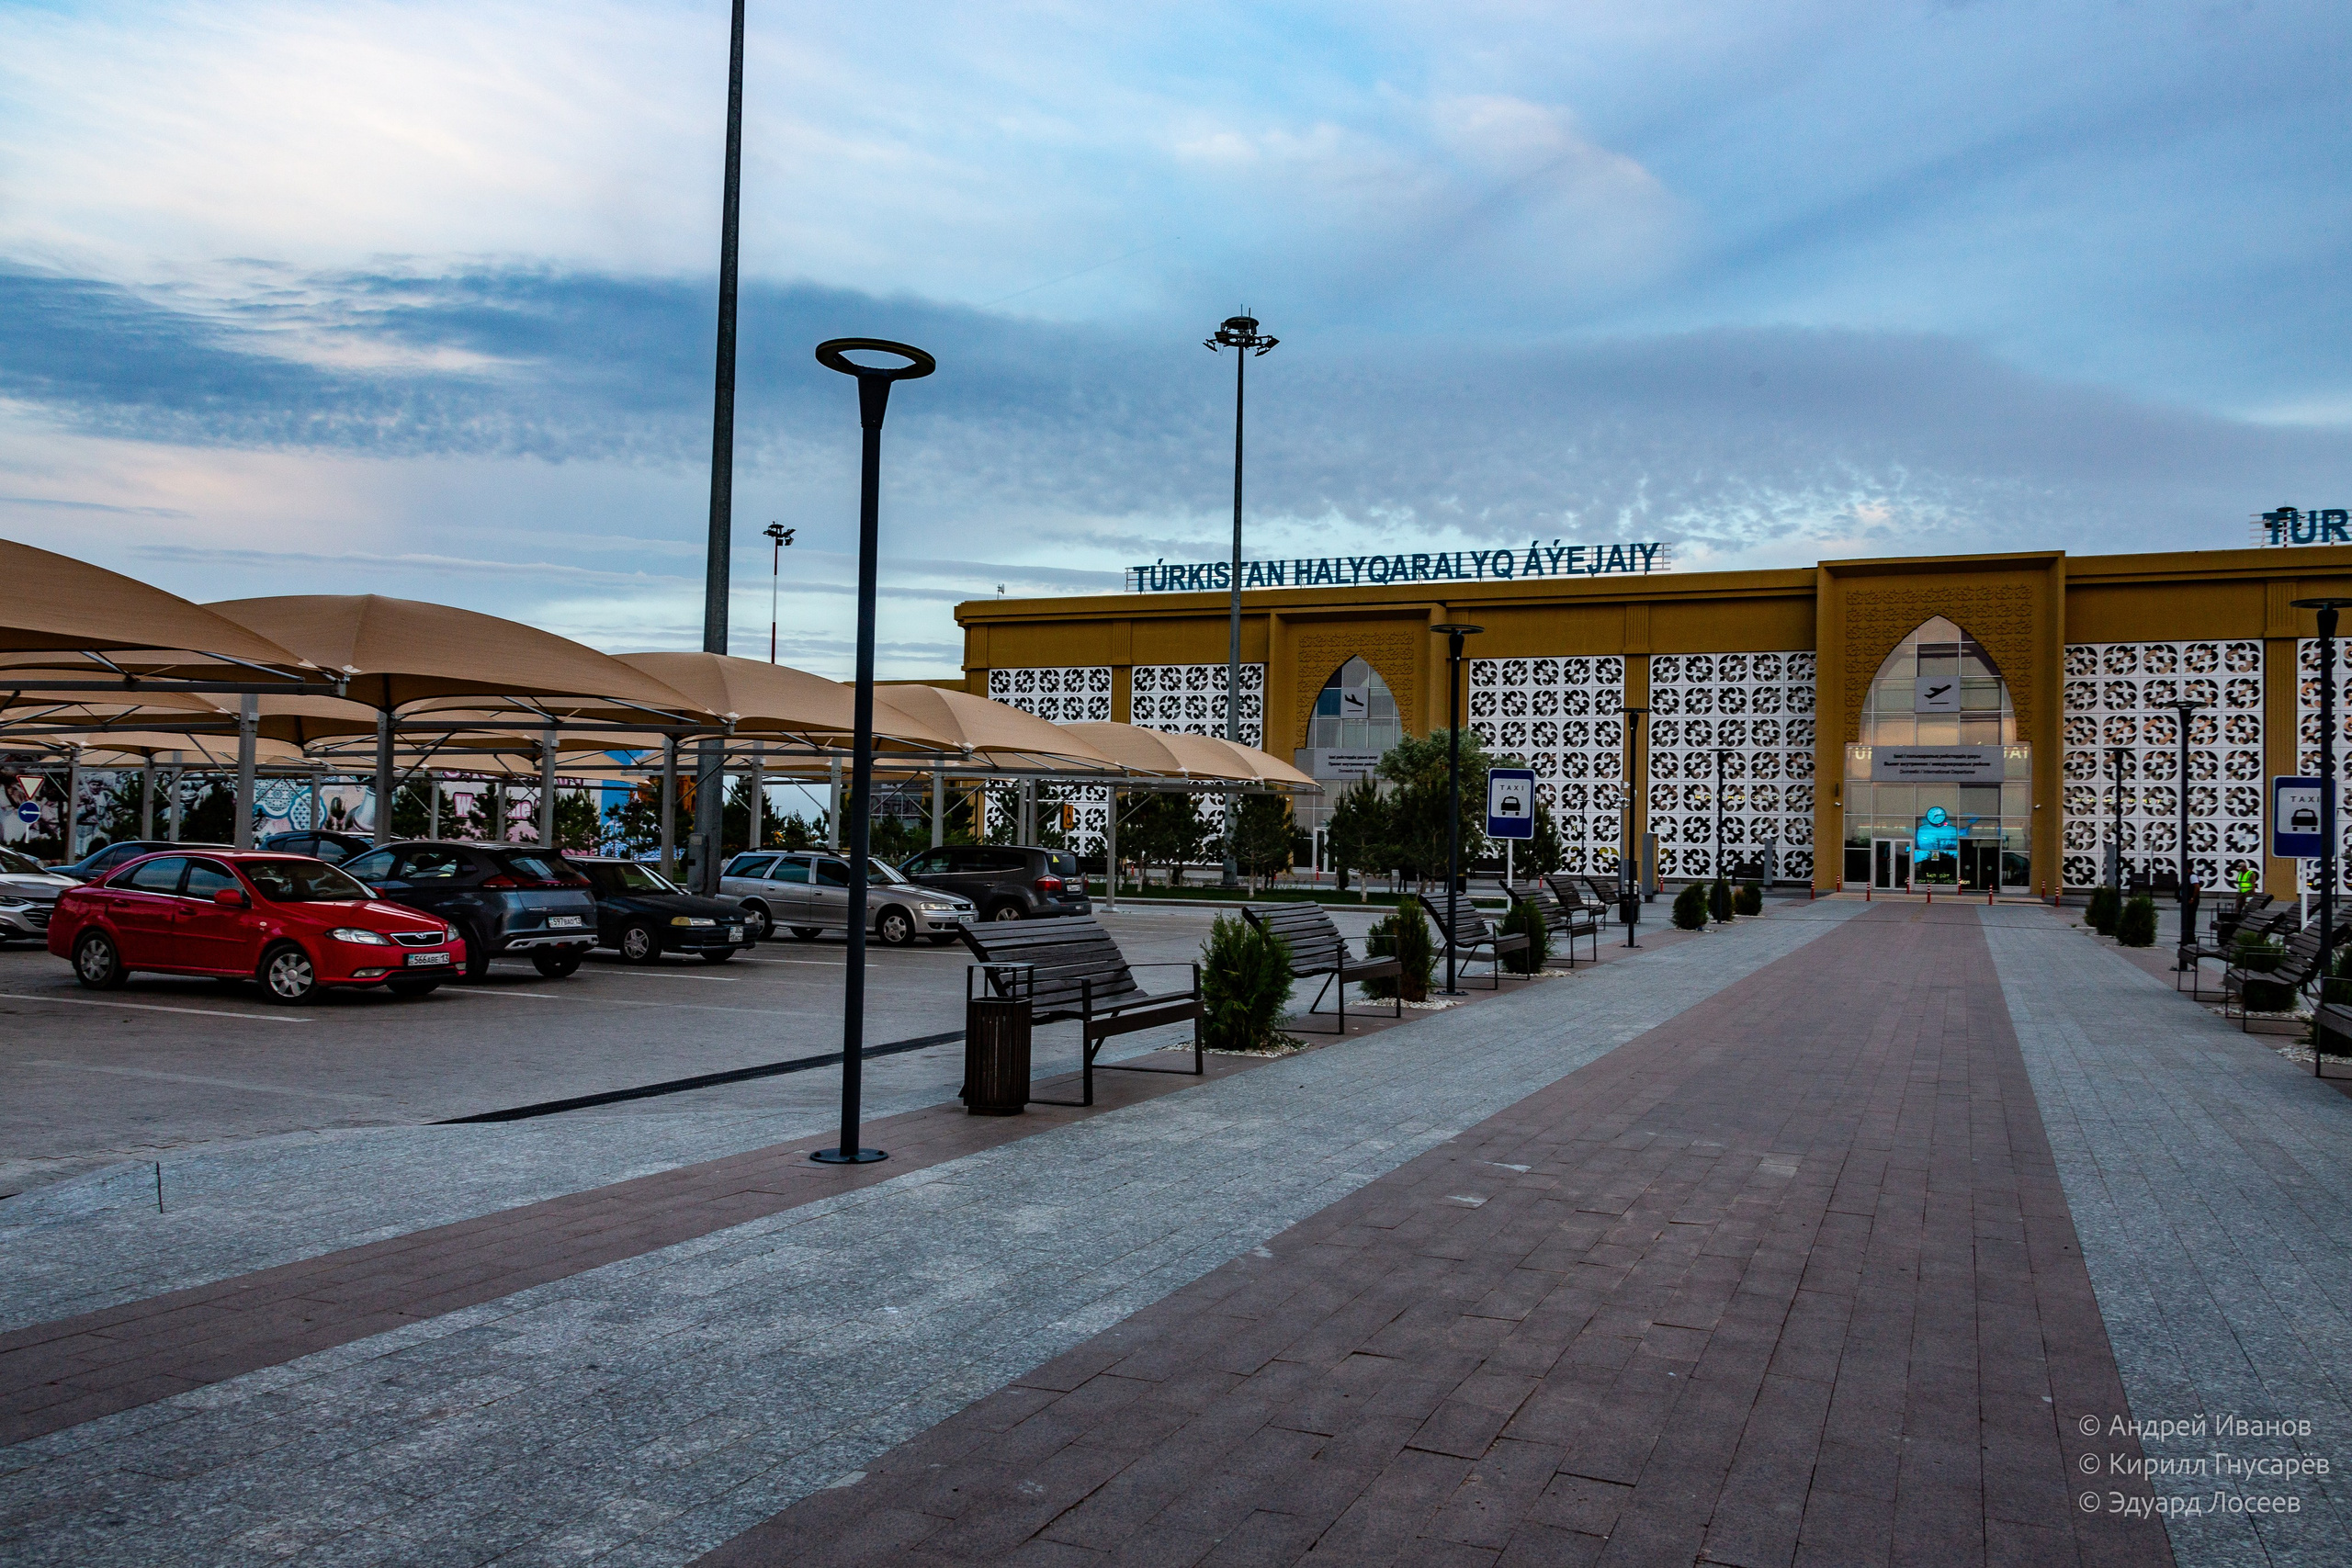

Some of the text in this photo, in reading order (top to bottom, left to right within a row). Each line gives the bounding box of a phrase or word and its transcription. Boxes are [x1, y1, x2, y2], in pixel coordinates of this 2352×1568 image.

[1133, 539, 1660, 592] TÚRKISAN HALYQARALYQ ÁÝEJAIY
